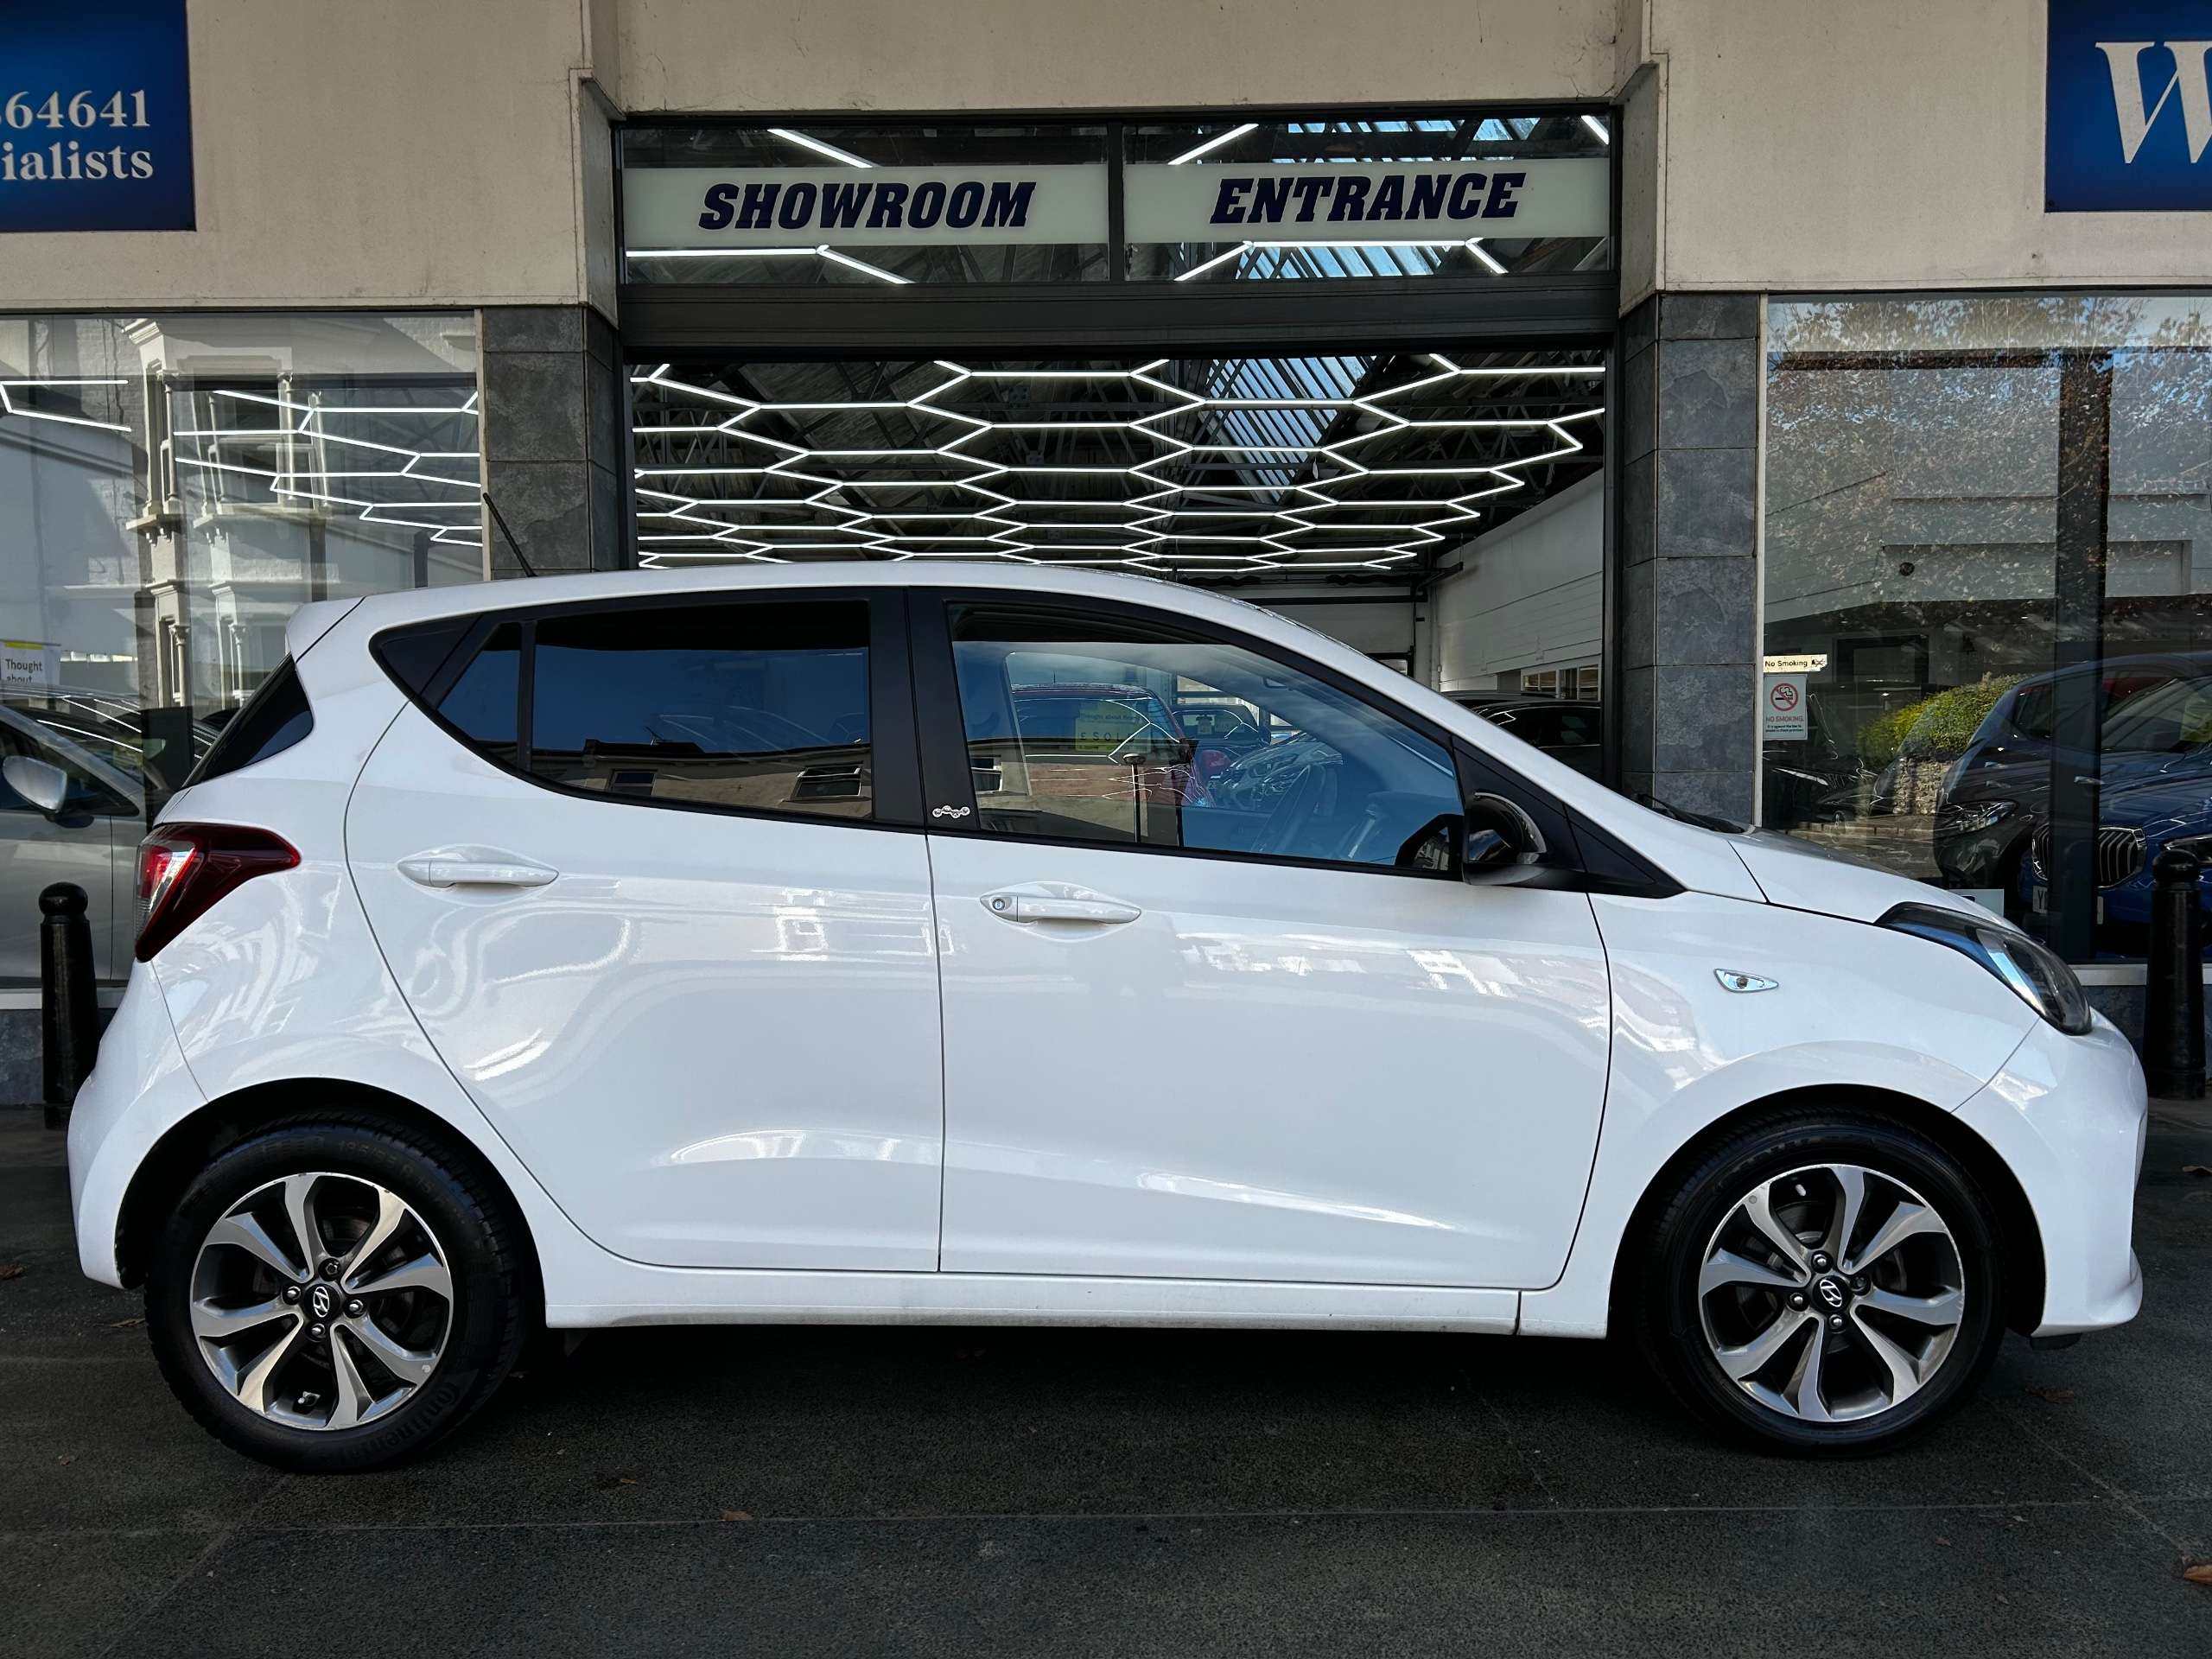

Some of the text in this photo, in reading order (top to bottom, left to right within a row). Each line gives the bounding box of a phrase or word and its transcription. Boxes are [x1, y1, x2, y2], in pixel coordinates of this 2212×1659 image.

[0, 89, 151, 129] 64641
[2094, 41, 2212, 164] W
[697, 172, 1527, 231] SHOWROOM ENTRANCE
[5, 658, 42, 673] Thought
